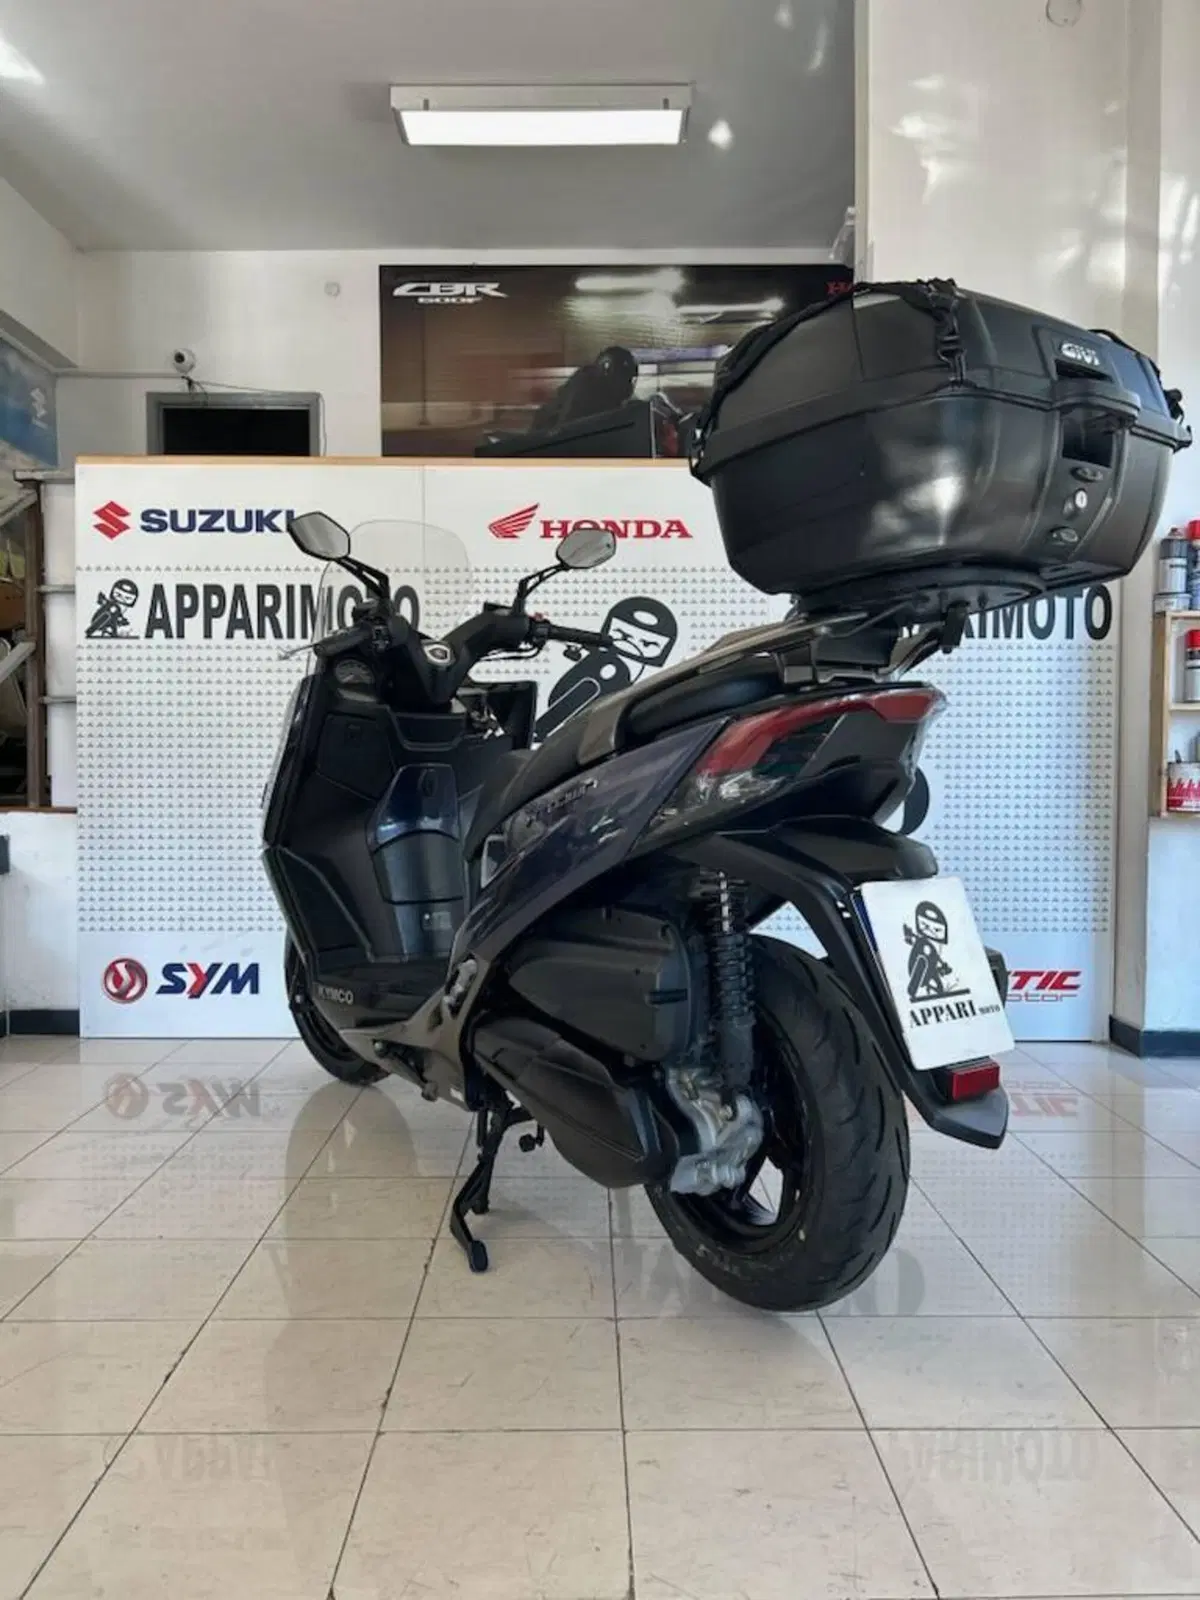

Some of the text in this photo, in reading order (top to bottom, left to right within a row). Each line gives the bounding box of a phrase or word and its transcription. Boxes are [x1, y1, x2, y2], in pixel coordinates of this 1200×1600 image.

[393, 282, 509, 297] CBR
[140, 508, 295, 533] SUZUKI
[155, 963, 259, 999] SYM
[1006, 971, 1081, 990] TIC
[1005, 992, 1077, 1003] otor
[908, 1000, 977, 1028] APPARI
